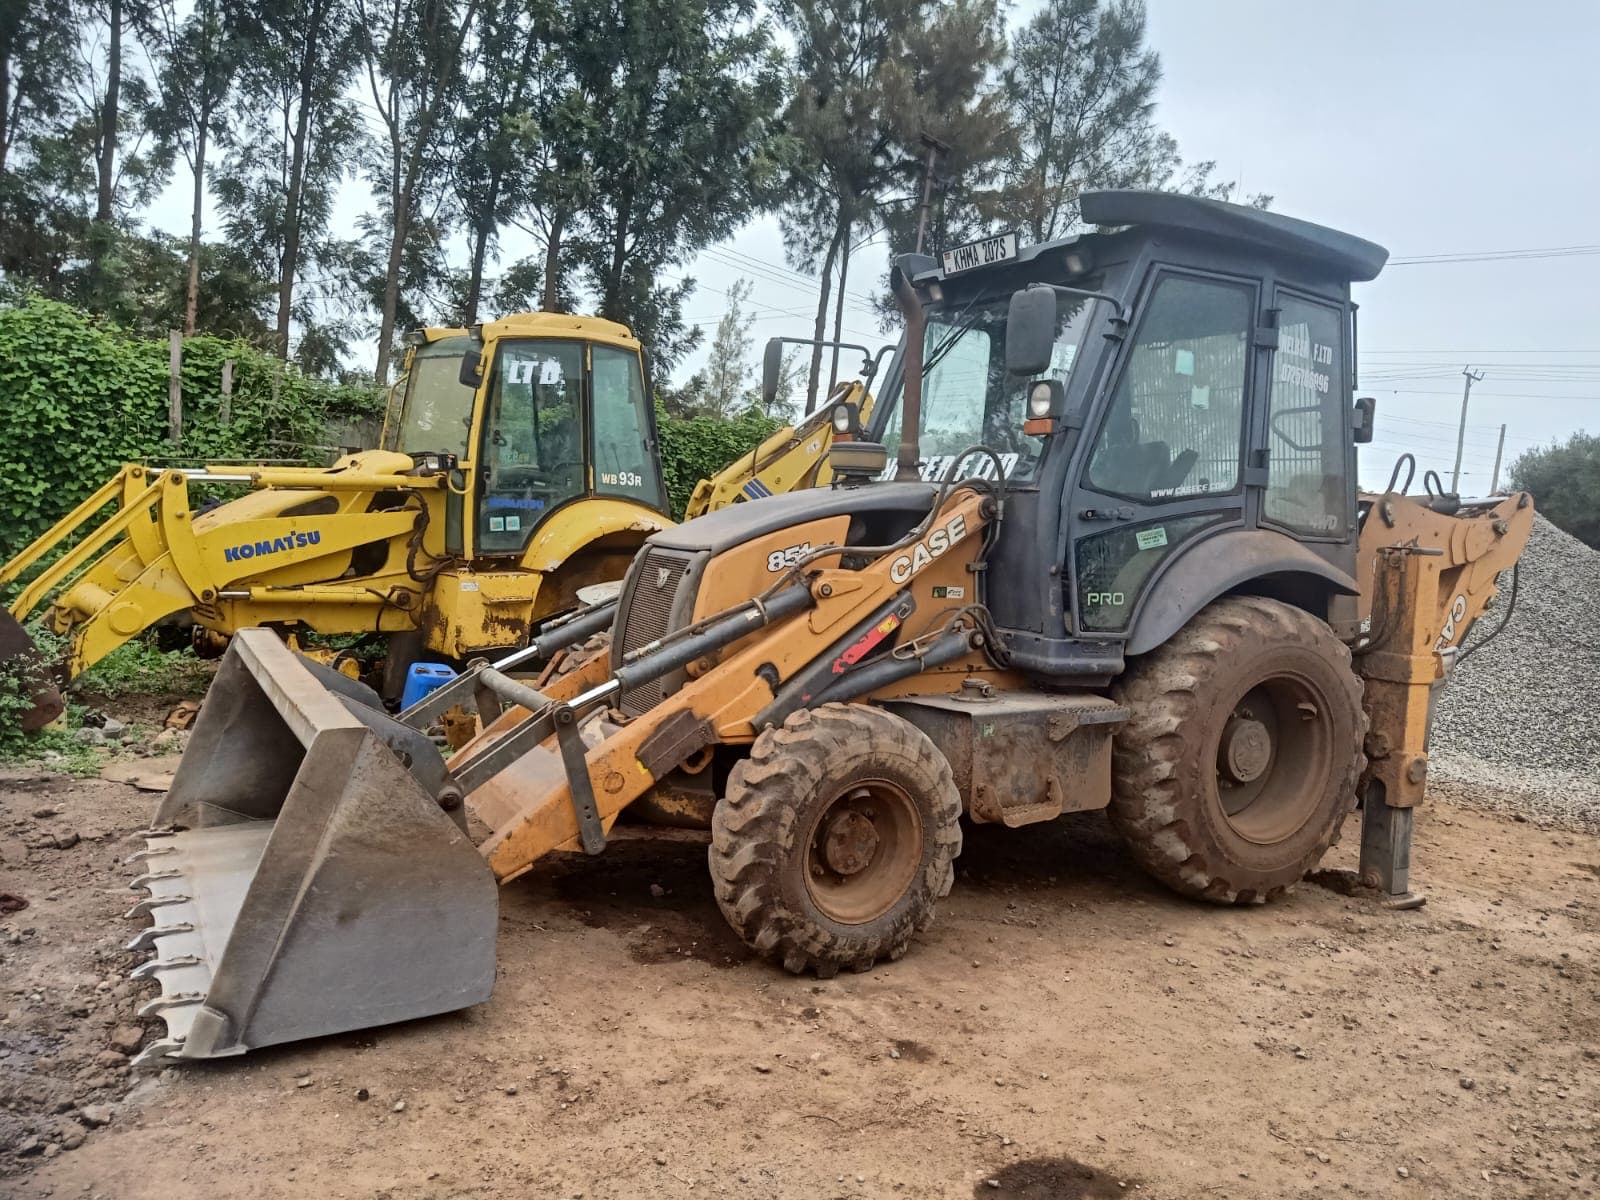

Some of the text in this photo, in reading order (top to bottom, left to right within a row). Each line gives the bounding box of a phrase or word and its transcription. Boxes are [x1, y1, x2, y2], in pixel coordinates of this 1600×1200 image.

[953, 237, 1006, 271] KHMA 207S
[224, 530, 321, 562] KOMATSU
[889, 513, 968, 584] CASE
[1087, 592, 1124, 606] PRO
